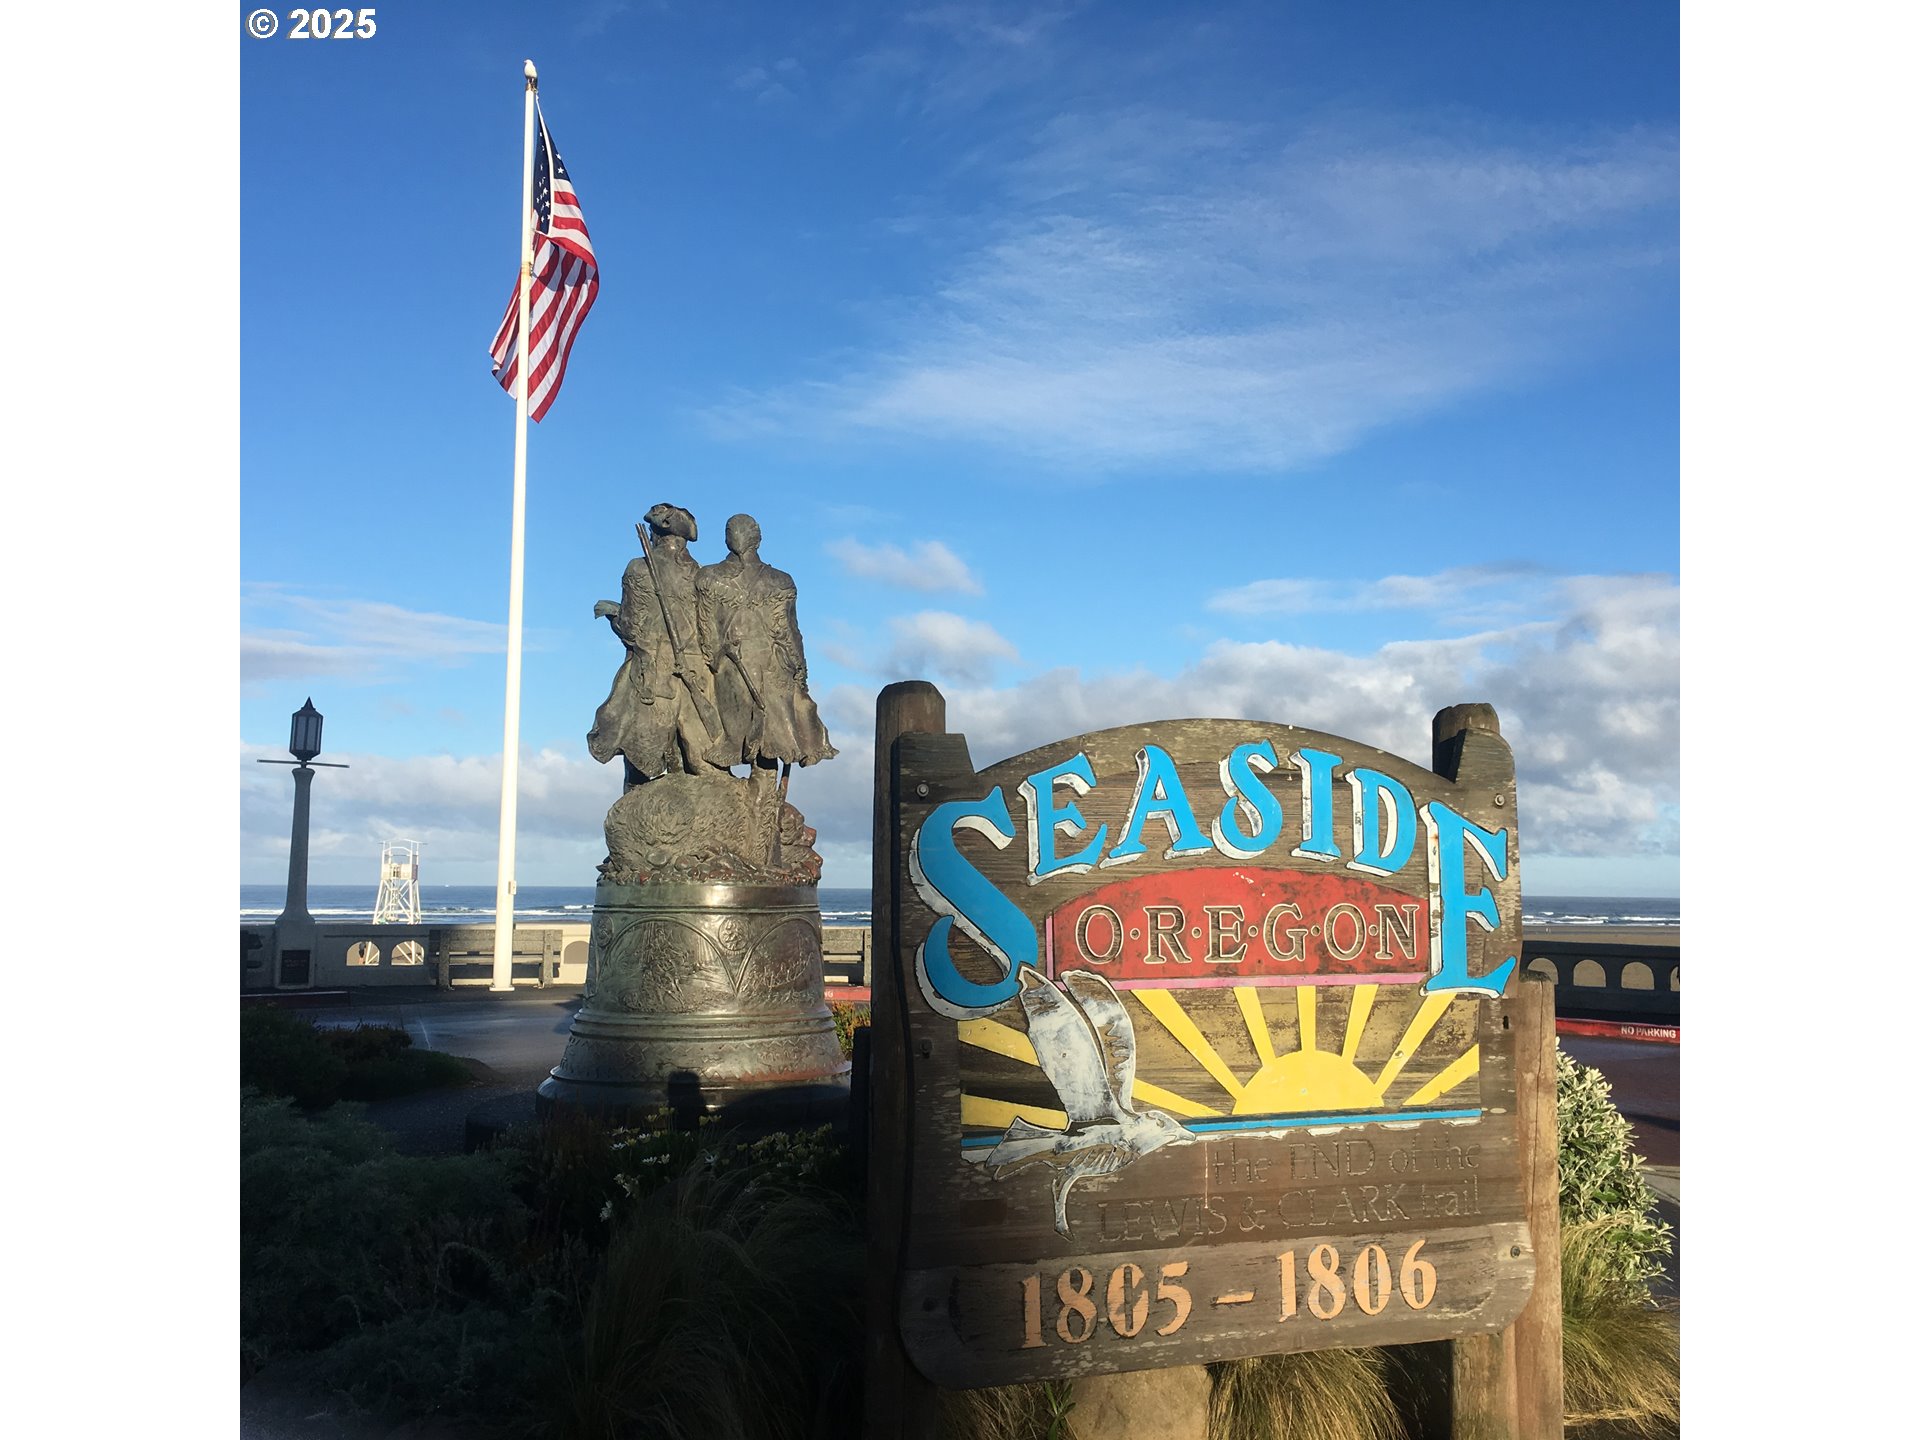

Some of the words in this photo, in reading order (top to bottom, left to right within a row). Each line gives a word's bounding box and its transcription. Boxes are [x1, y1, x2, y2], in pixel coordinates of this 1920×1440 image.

[908, 738, 1517, 1021] SEASIDE
[1621, 1026, 1635, 1035] NO
[1636, 1027, 1677, 1039] PARKING
[1212, 1142, 1272, 1185] the
[1290, 1138, 1376, 1180] END
[1388, 1132, 1421, 1174] of
[1422, 1131, 1481, 1171] the
[1097, 1197, 1228, 1242] LEWIS
[1239, 1196, 1266, 1232] &
[1278, 1183, 1412, 1228] CLARK
[1421, 1173, 1482, 1218] trail
[1020, 1259, 1193, 1349] 1805
[1275, 1239, 1438, 1323] 1806
